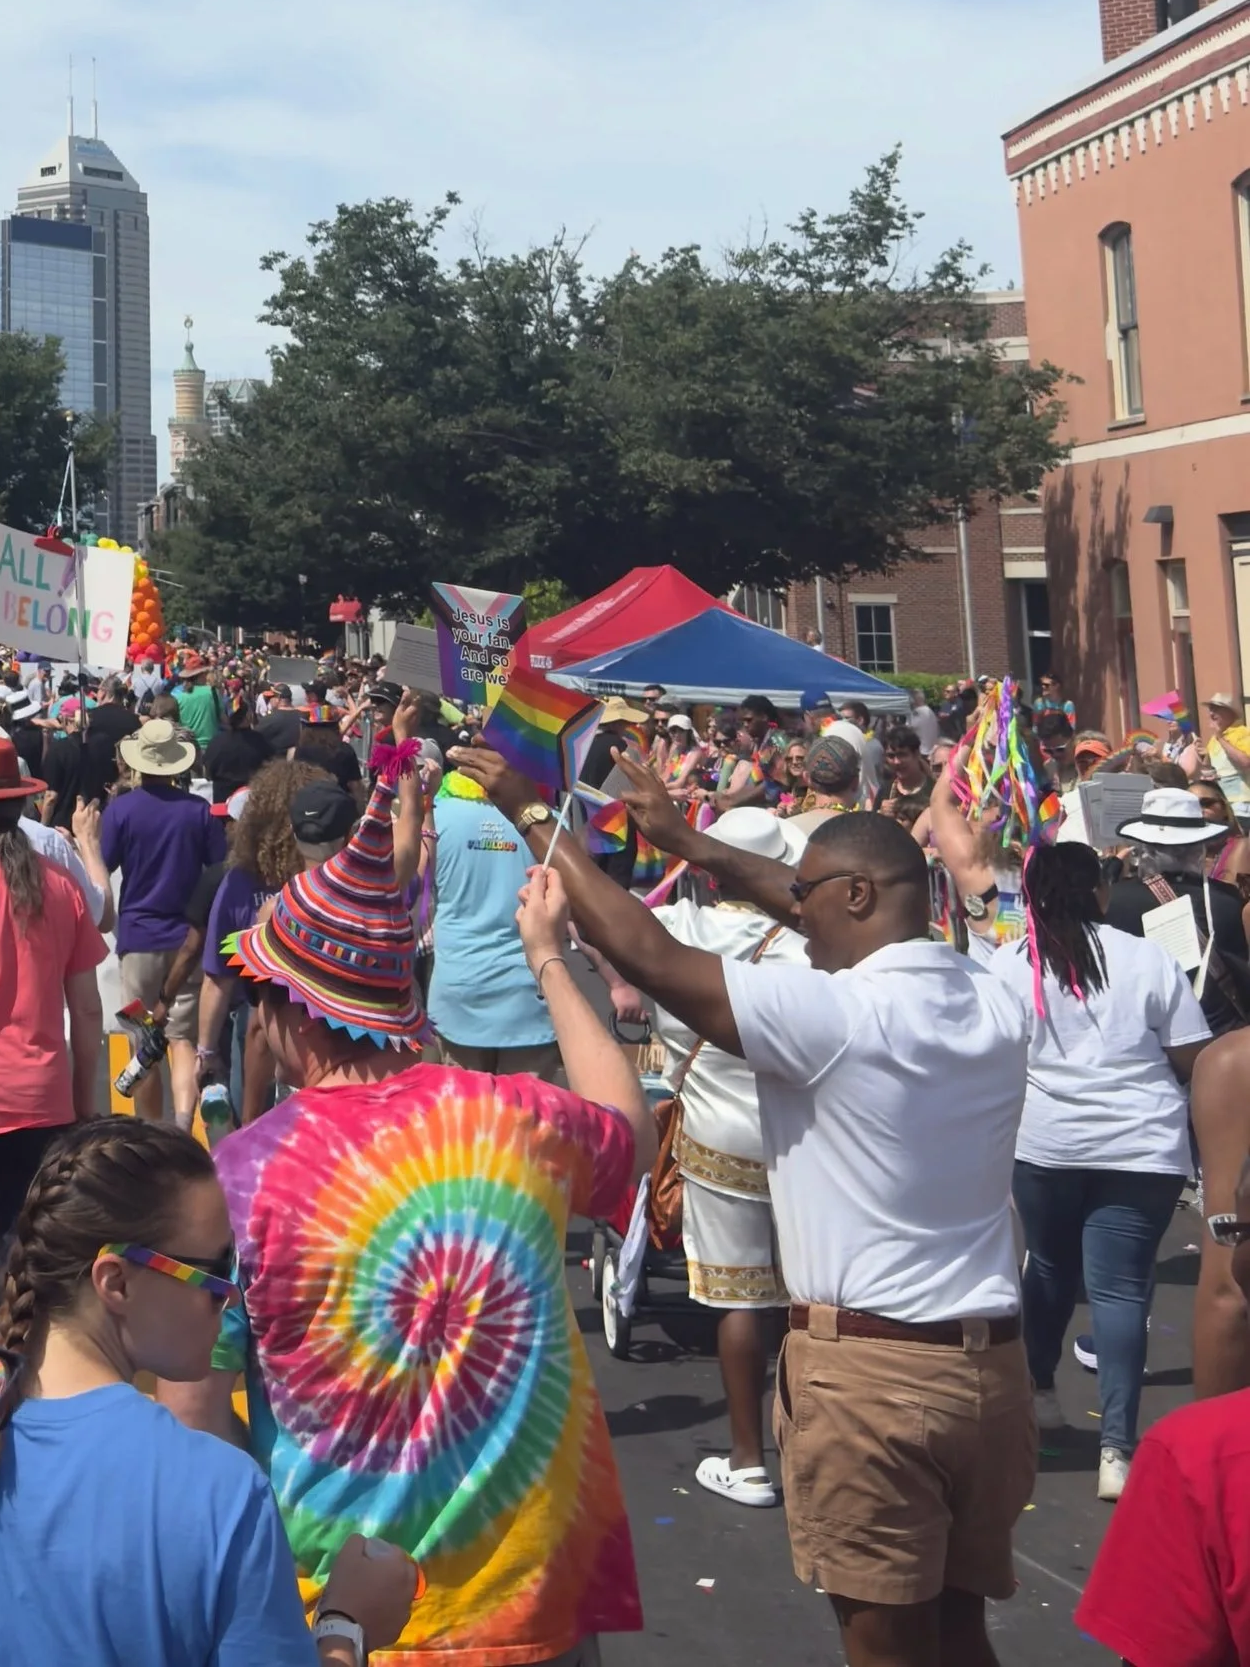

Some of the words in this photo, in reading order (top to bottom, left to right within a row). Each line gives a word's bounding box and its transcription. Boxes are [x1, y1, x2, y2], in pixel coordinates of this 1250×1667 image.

[4, 590, 115, 643] BELONG
[453, 608, 493, 626] Jesus
[497, 614, 509, 630] is
[453, 629, 483, 643] your
[461, 647, 488, 664] And
[492, 655, 509, 667] so
[462, 667, 483, 682] are
